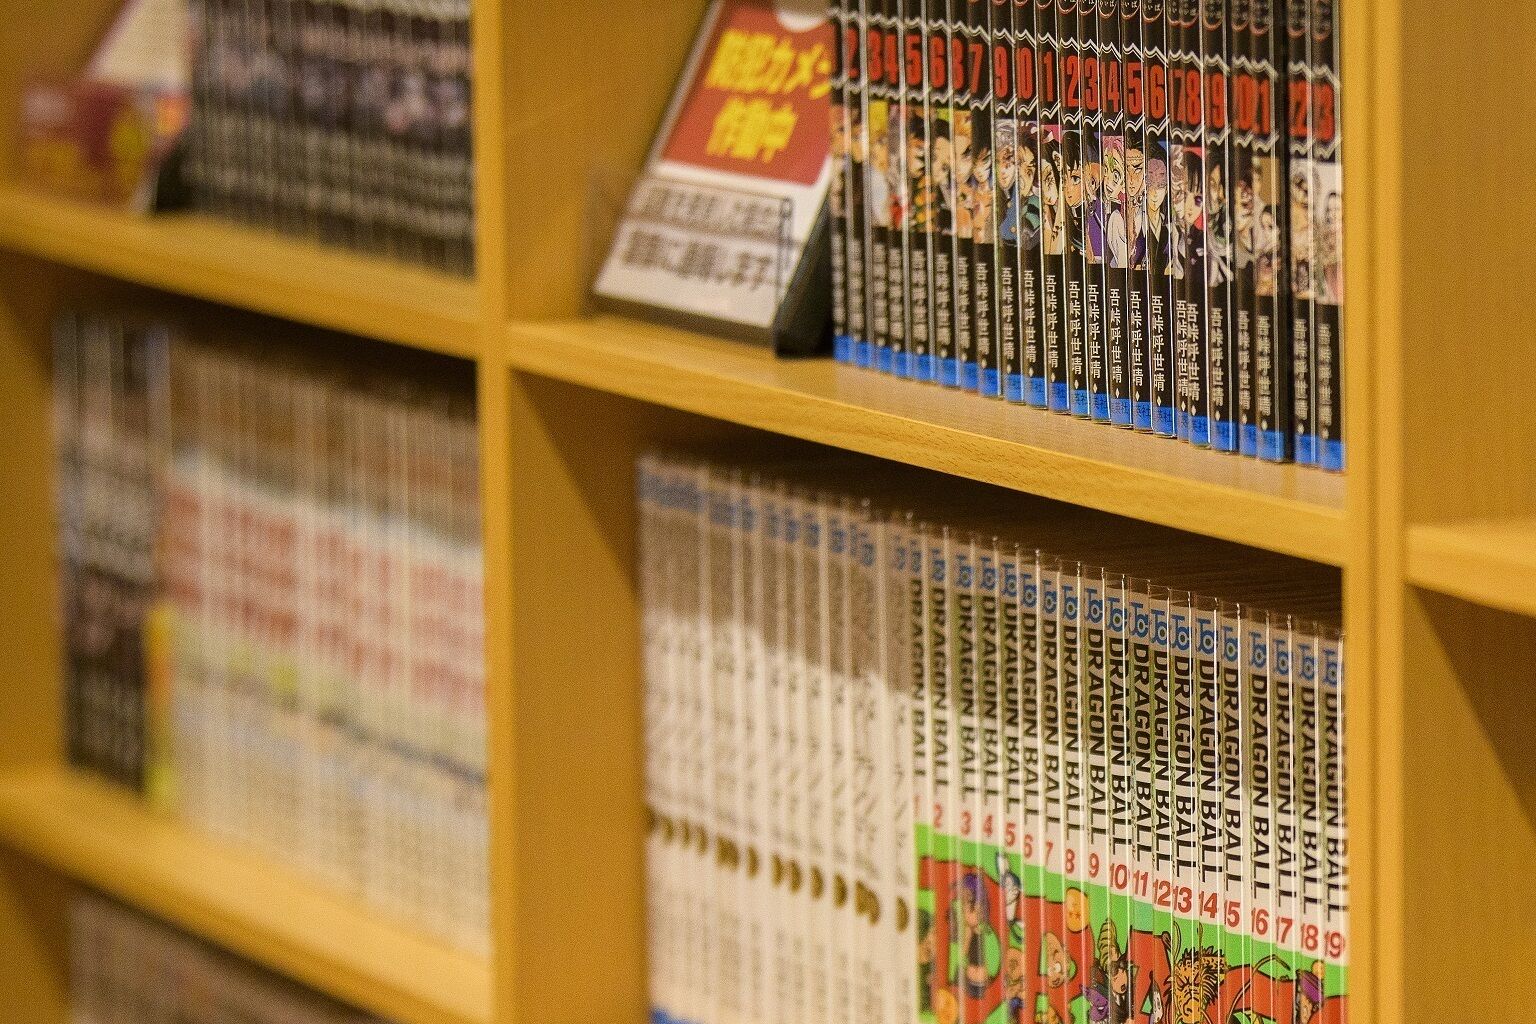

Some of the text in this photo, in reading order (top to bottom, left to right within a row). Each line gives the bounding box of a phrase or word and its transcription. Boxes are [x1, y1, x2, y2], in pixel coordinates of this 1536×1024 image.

[867, 29, 884, 81] 3
[905, 34, 922, 85] 5
[929, 36, 946, 88] 6
[969, 43, 984, 94] 7
[994, 46, 1009, 98] 9
[1101, 61, 1119, 113] 14
[932, 587, 949, 792] DRAGON BALL
[959, 594, 976, 802] DRAGON BALL
[982, 595, 999, 804] DRAGON BALL
[1003, 602, 1020, 813] DRAGON BALL
[1021, 613, 1039, 825] DRAGON BALL
[1042, 619, 1061, 832] DRAGON BALL
[1062, 625, 1084, 841] DRAGON BALL
[1087, 628, 1108, 845] DRAGON BALL
[1108, 637, 1132, 855] DRAGON BALL
[1132, 642, 1152, 862] DRAGON BALL
[1153, 650, 1172, 871] DRAGON BALL
[1174, 655, 1197, 877] DRAGON BALL
[1199, 659, 1222, 882] DRAGON BALL
[1223, 667, 1242, 892] DRAGON BALL
[1250, 673, 1271, 899] DRAGON BALL
[1276, 681, 1297, 908] DRAGON BALL
[1301, 686, 1322, 915] DRAGON BALL
[933, 803, 944, 829] 2
[961, 811, 972, 836] 3
[983, 814, 994, 838] 4
[1325, 692, 1347, 923] DRAGON BALL
[1005, 821, 1016, 847] 5
[1023, 834, 1034, 859] 6
[1045, 839, 1054, 866] 7
[1064, 848, 1076, 874] 8
[1088, 852, 1100, 879] 9
[1109, 863, 1128, 890] 10
[1133, 869, 1149, 897] 11
[1153, 878, 1171, 907] 12
[1172, 885, 1193, 913] 13
[1199, 891, 1218, 919] 14
[1224, 900, 1241, 928] 15
[1251, 907, 1270, 936] 16
[1276, 916, 1293, 944] 17
[1301, 923, 1319, 951] 18
[1325, 930, 1345, 959] 19
